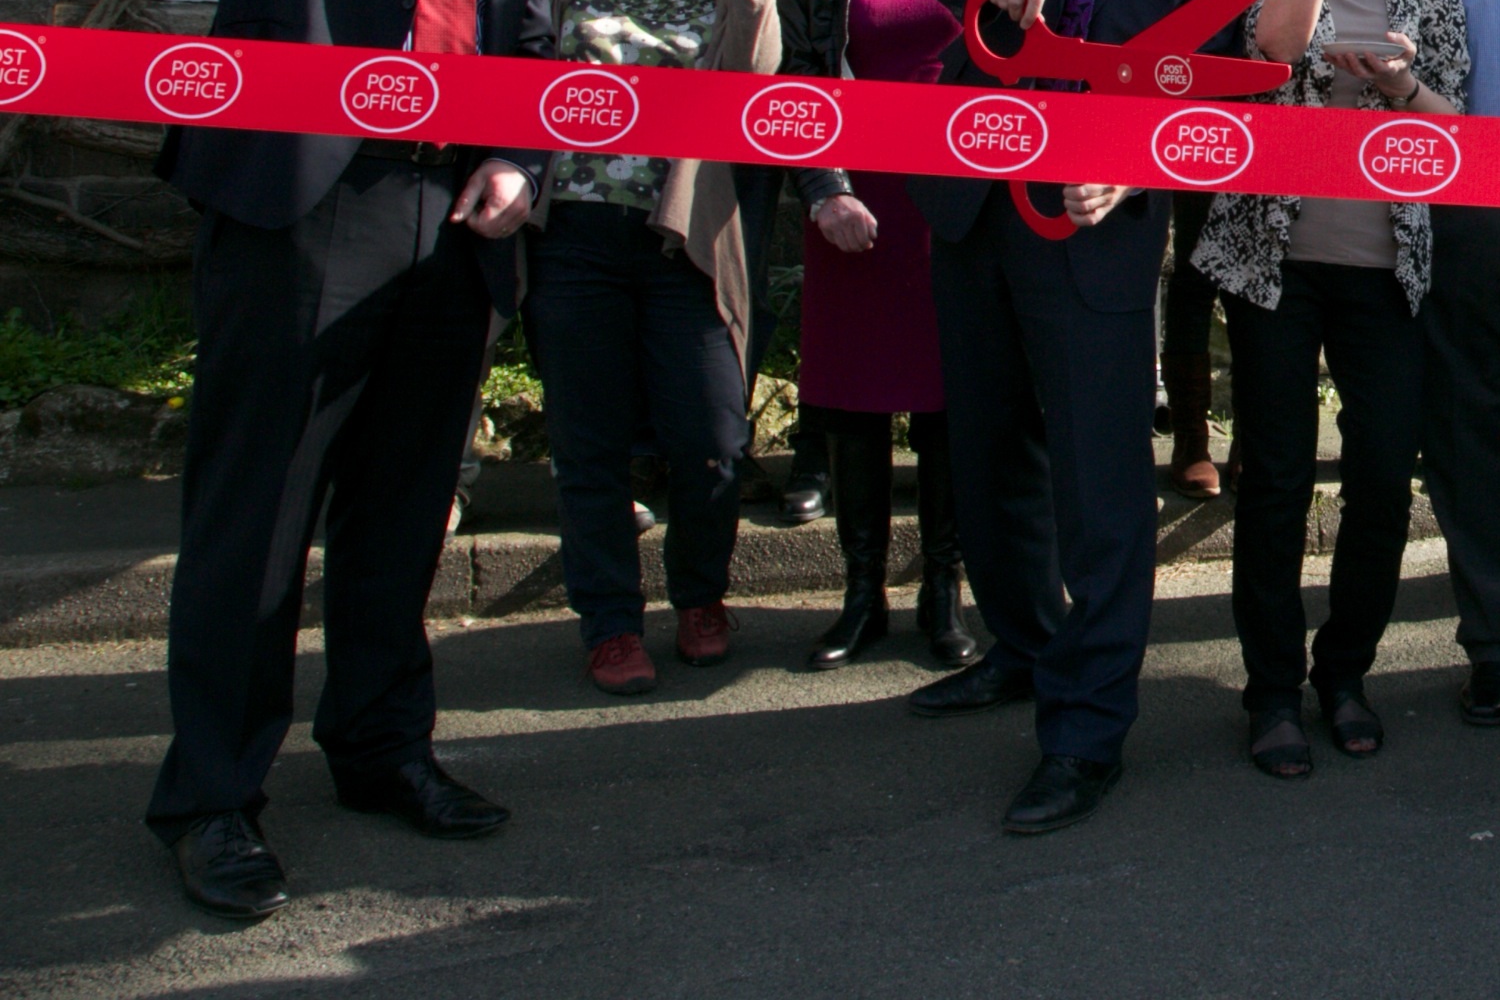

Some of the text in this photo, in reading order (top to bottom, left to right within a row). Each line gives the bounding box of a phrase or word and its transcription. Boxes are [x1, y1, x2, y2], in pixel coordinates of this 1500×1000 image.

[0, 48, 26, 65] ST
[0, 68, 30, 85] ICE
[172, 60, 222, 78] POST
[1163, 65, 1184, 74] POST
[156, 79, 226, 99] OFFICE
[367, 74, 418, 92] POST
[1160, 75, 1187, 84] OFFICE
[352, 92, 422, 112] OFFICE
[566, 87, 618, 106] POST
[551, 106, 622, 126] OFFICE
[769, 100, 821, 118] POST
[754, 118, 826, 139] OFFICE
[974, 112, 1026, 131] POST
[959, 131, 1031, 152] OFFICE
[1178, 125, 1232, 144] POST
[1164, 144, 1237, 164] OFFICE
[1386, 137, 1438, 155] POST
[1371, 156, 1444, 176] OFFICE
